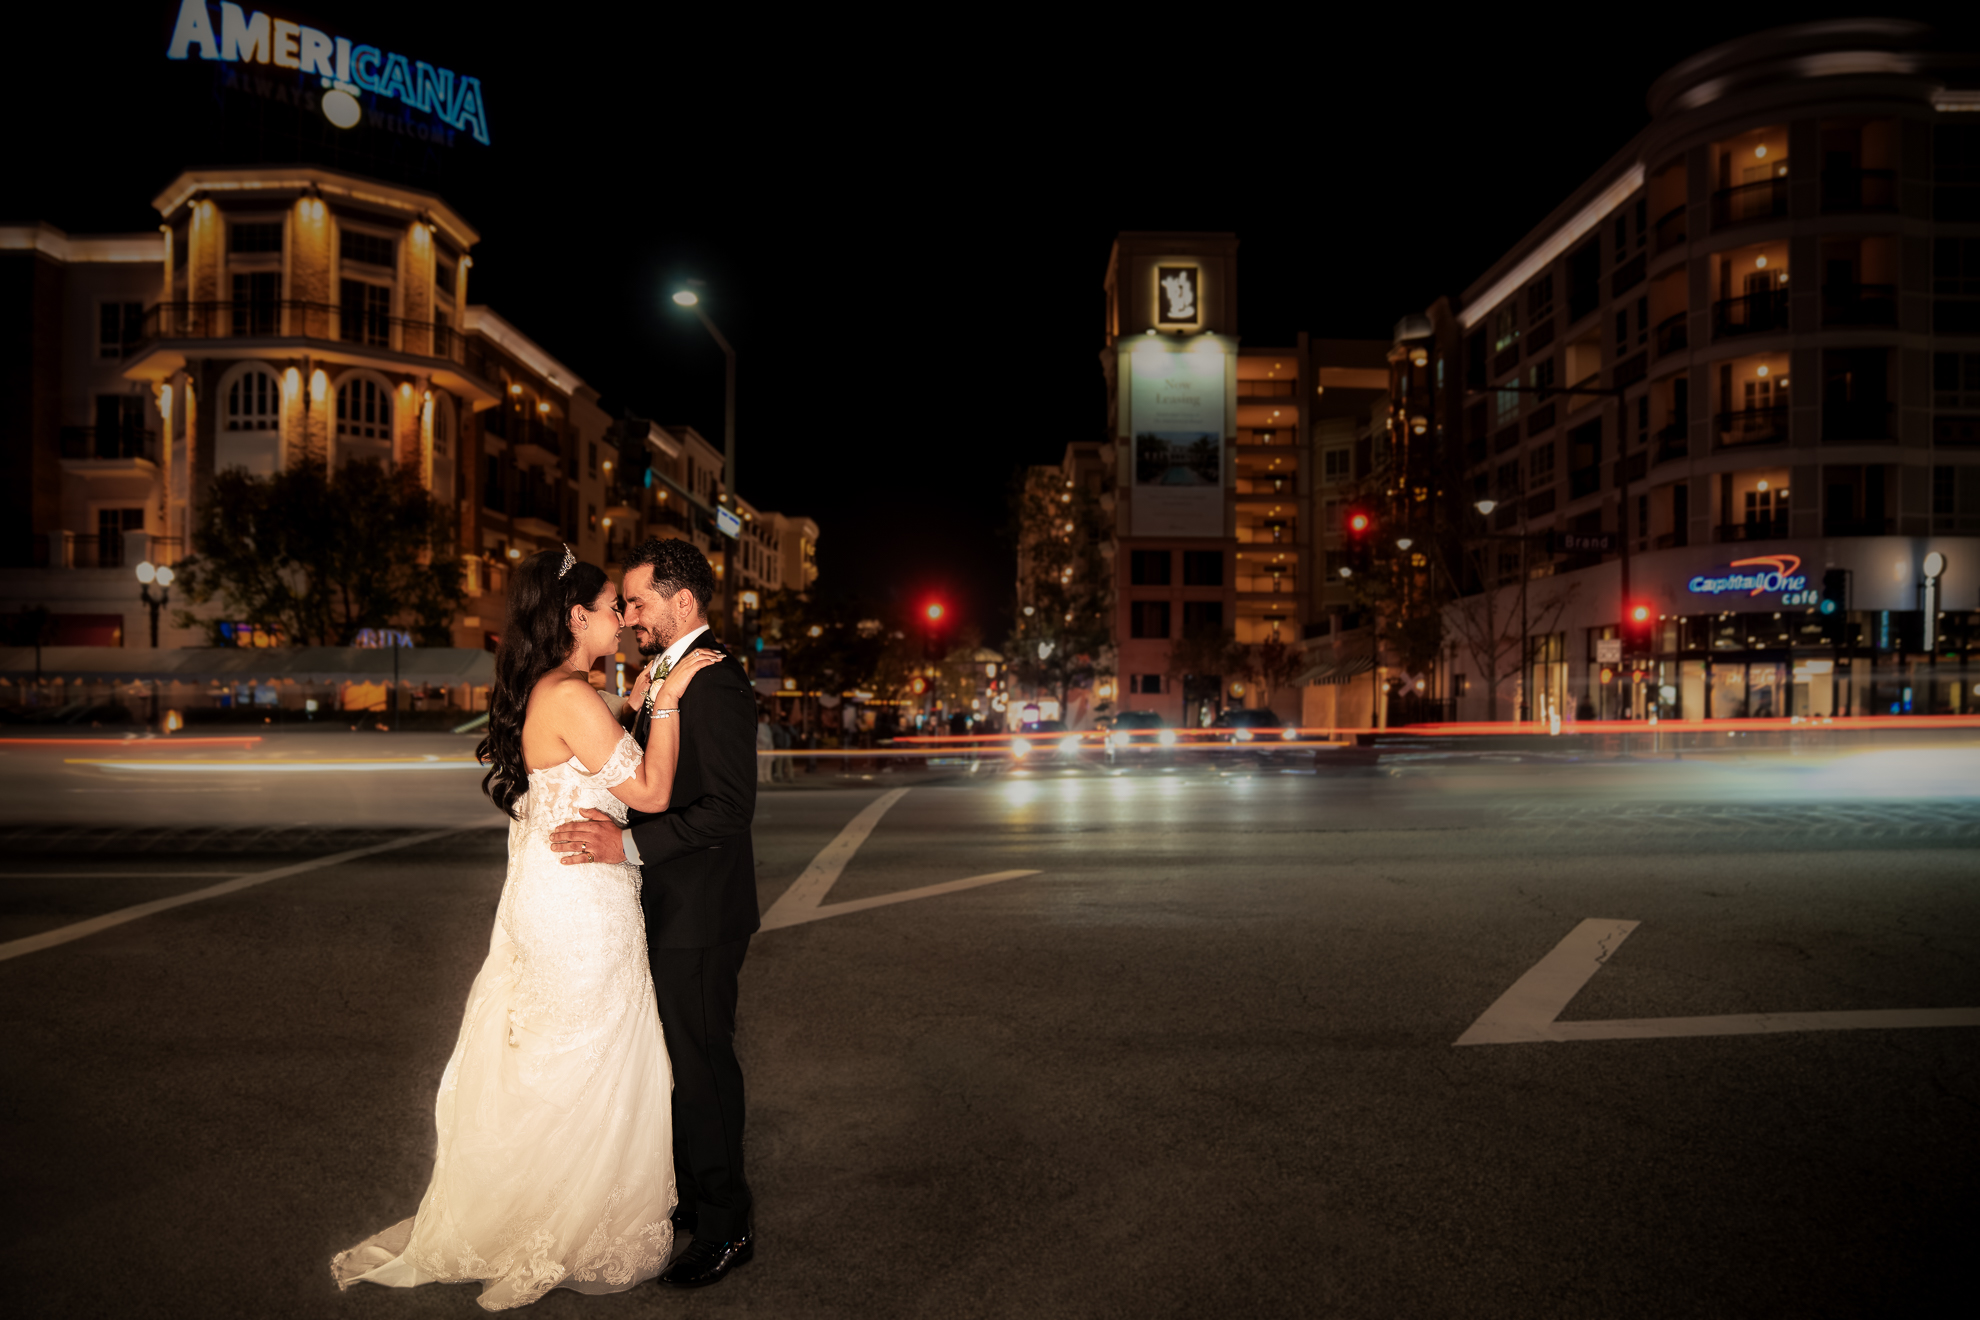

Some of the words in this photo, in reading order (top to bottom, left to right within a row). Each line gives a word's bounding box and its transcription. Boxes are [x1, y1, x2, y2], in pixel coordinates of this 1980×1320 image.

[166, 0, 490, 146] AMERICANA
[225, 73, 316, 111] ALWAYS
[368, 110, 455, 148] WELCOME
[1165, 379, 1191, 389] Now
[1156, 393, 1200, 406] Leasing
[1565, 534, 1609, 549] Brand
